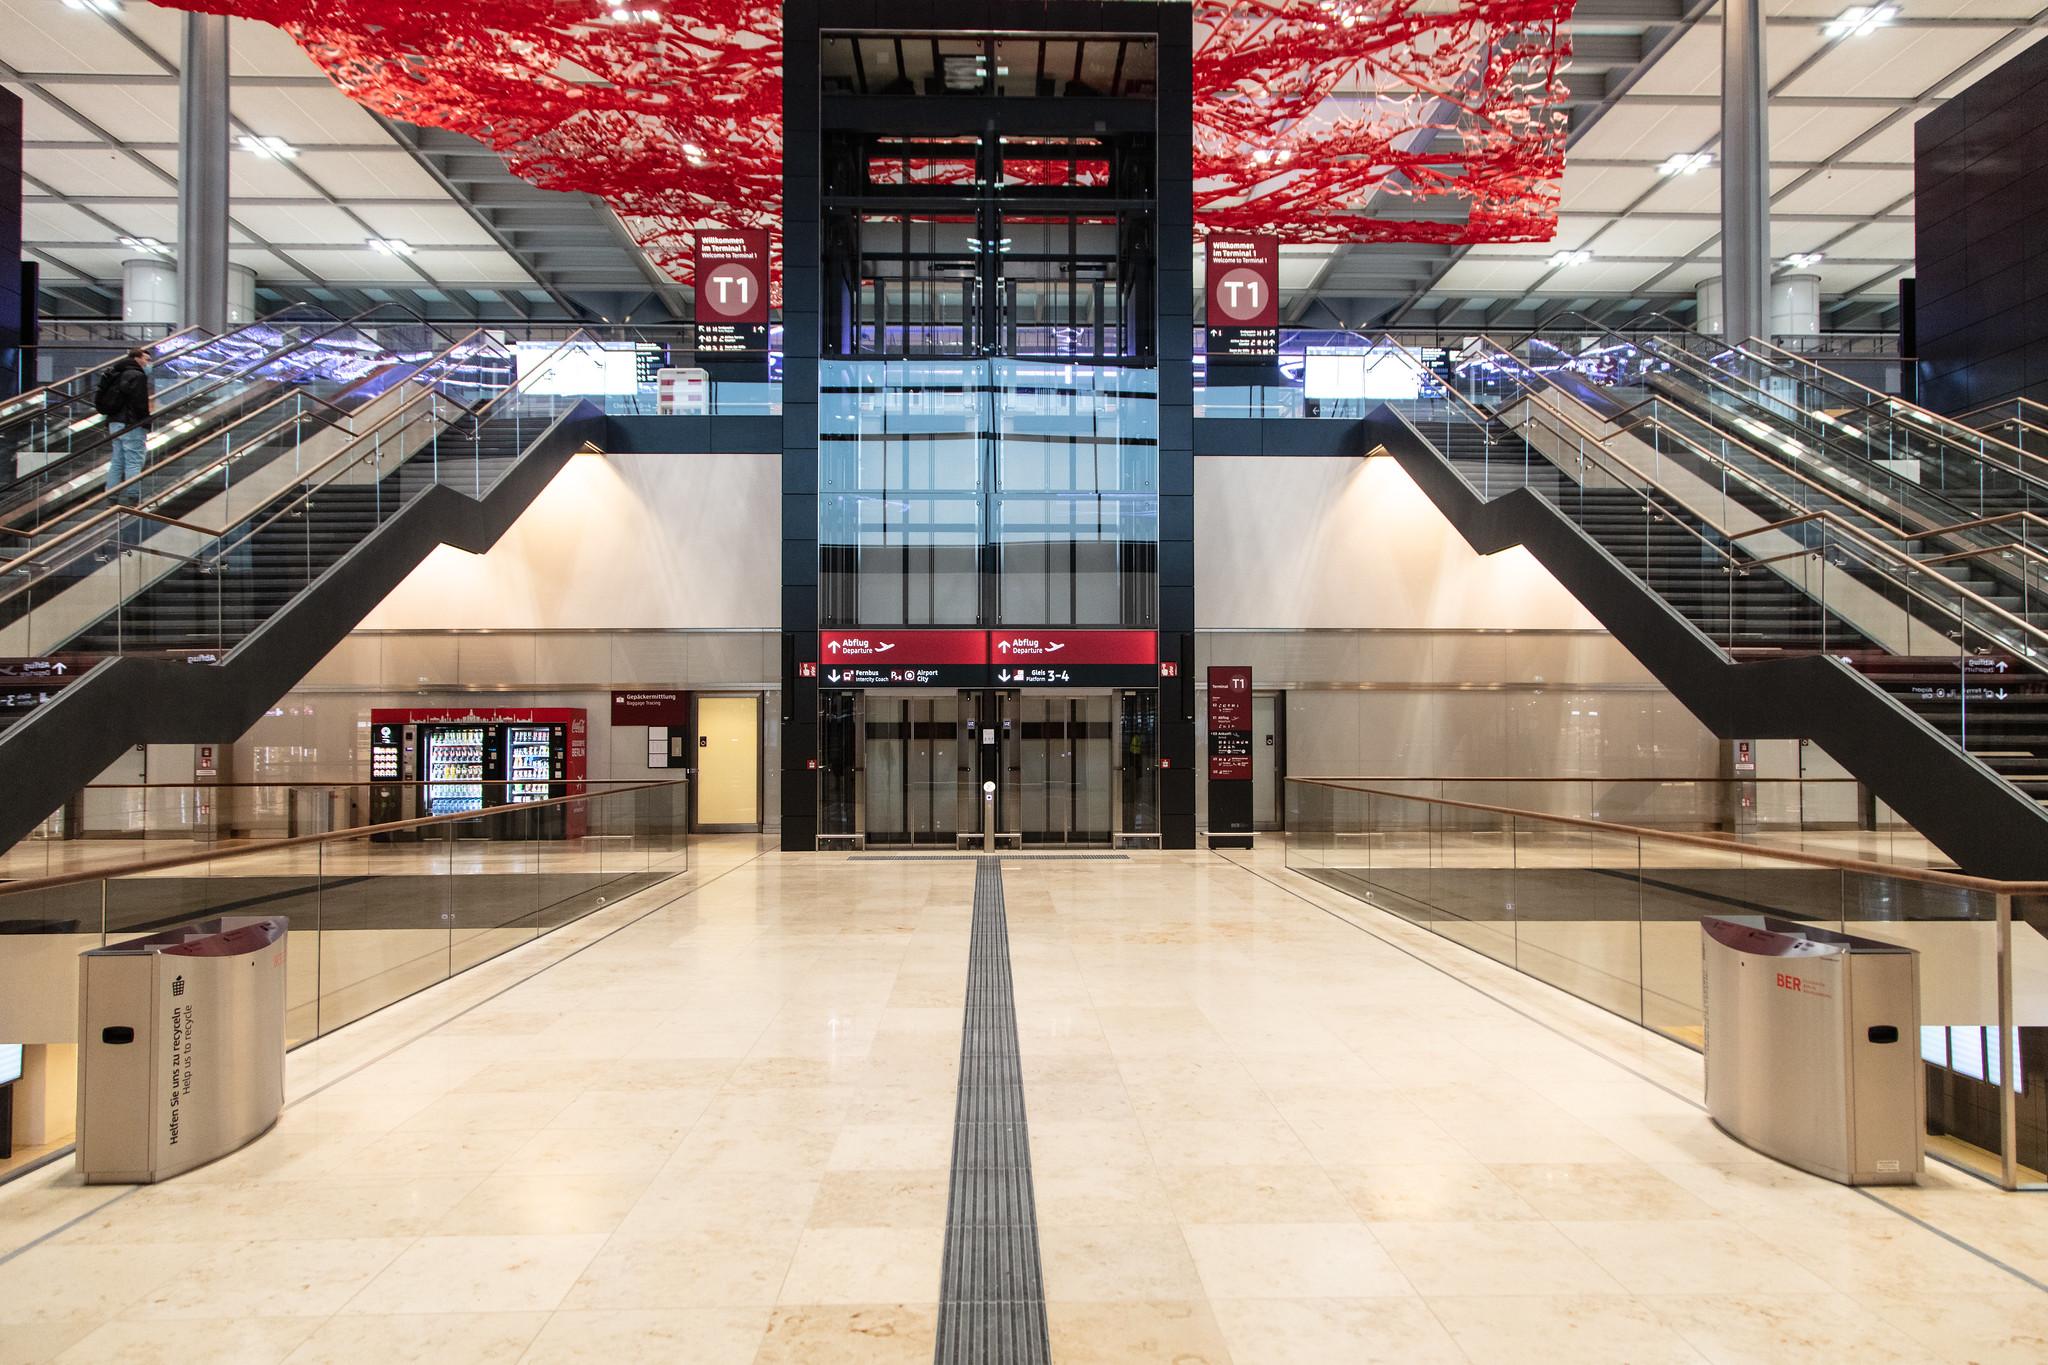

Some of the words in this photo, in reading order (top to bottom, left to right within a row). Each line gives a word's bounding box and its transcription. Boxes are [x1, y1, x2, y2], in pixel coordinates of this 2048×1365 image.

[713, 277, 748, 304] T1
[1224, 281, 1260, 308] T1
[842, 639, 869, 648] Abflug
[1012, 639, 1039, 648] Abflug
[1232, 679, 1245, 688] T1
[1776, 972, 1801, 992] BER
[172, 1007, 182, 1051] recyceln
[185, 1005, 193, 1040] recycle
[184, 1043, 191, 1053] to
[173, 1053, 180, 1067] zu
[184, 1056, 190, 1070] us
[182, 1072, 192, 1095] Help
[170, 1091, 180, 1107] Sie
[170, 1108, 180, 1145] Helfen
